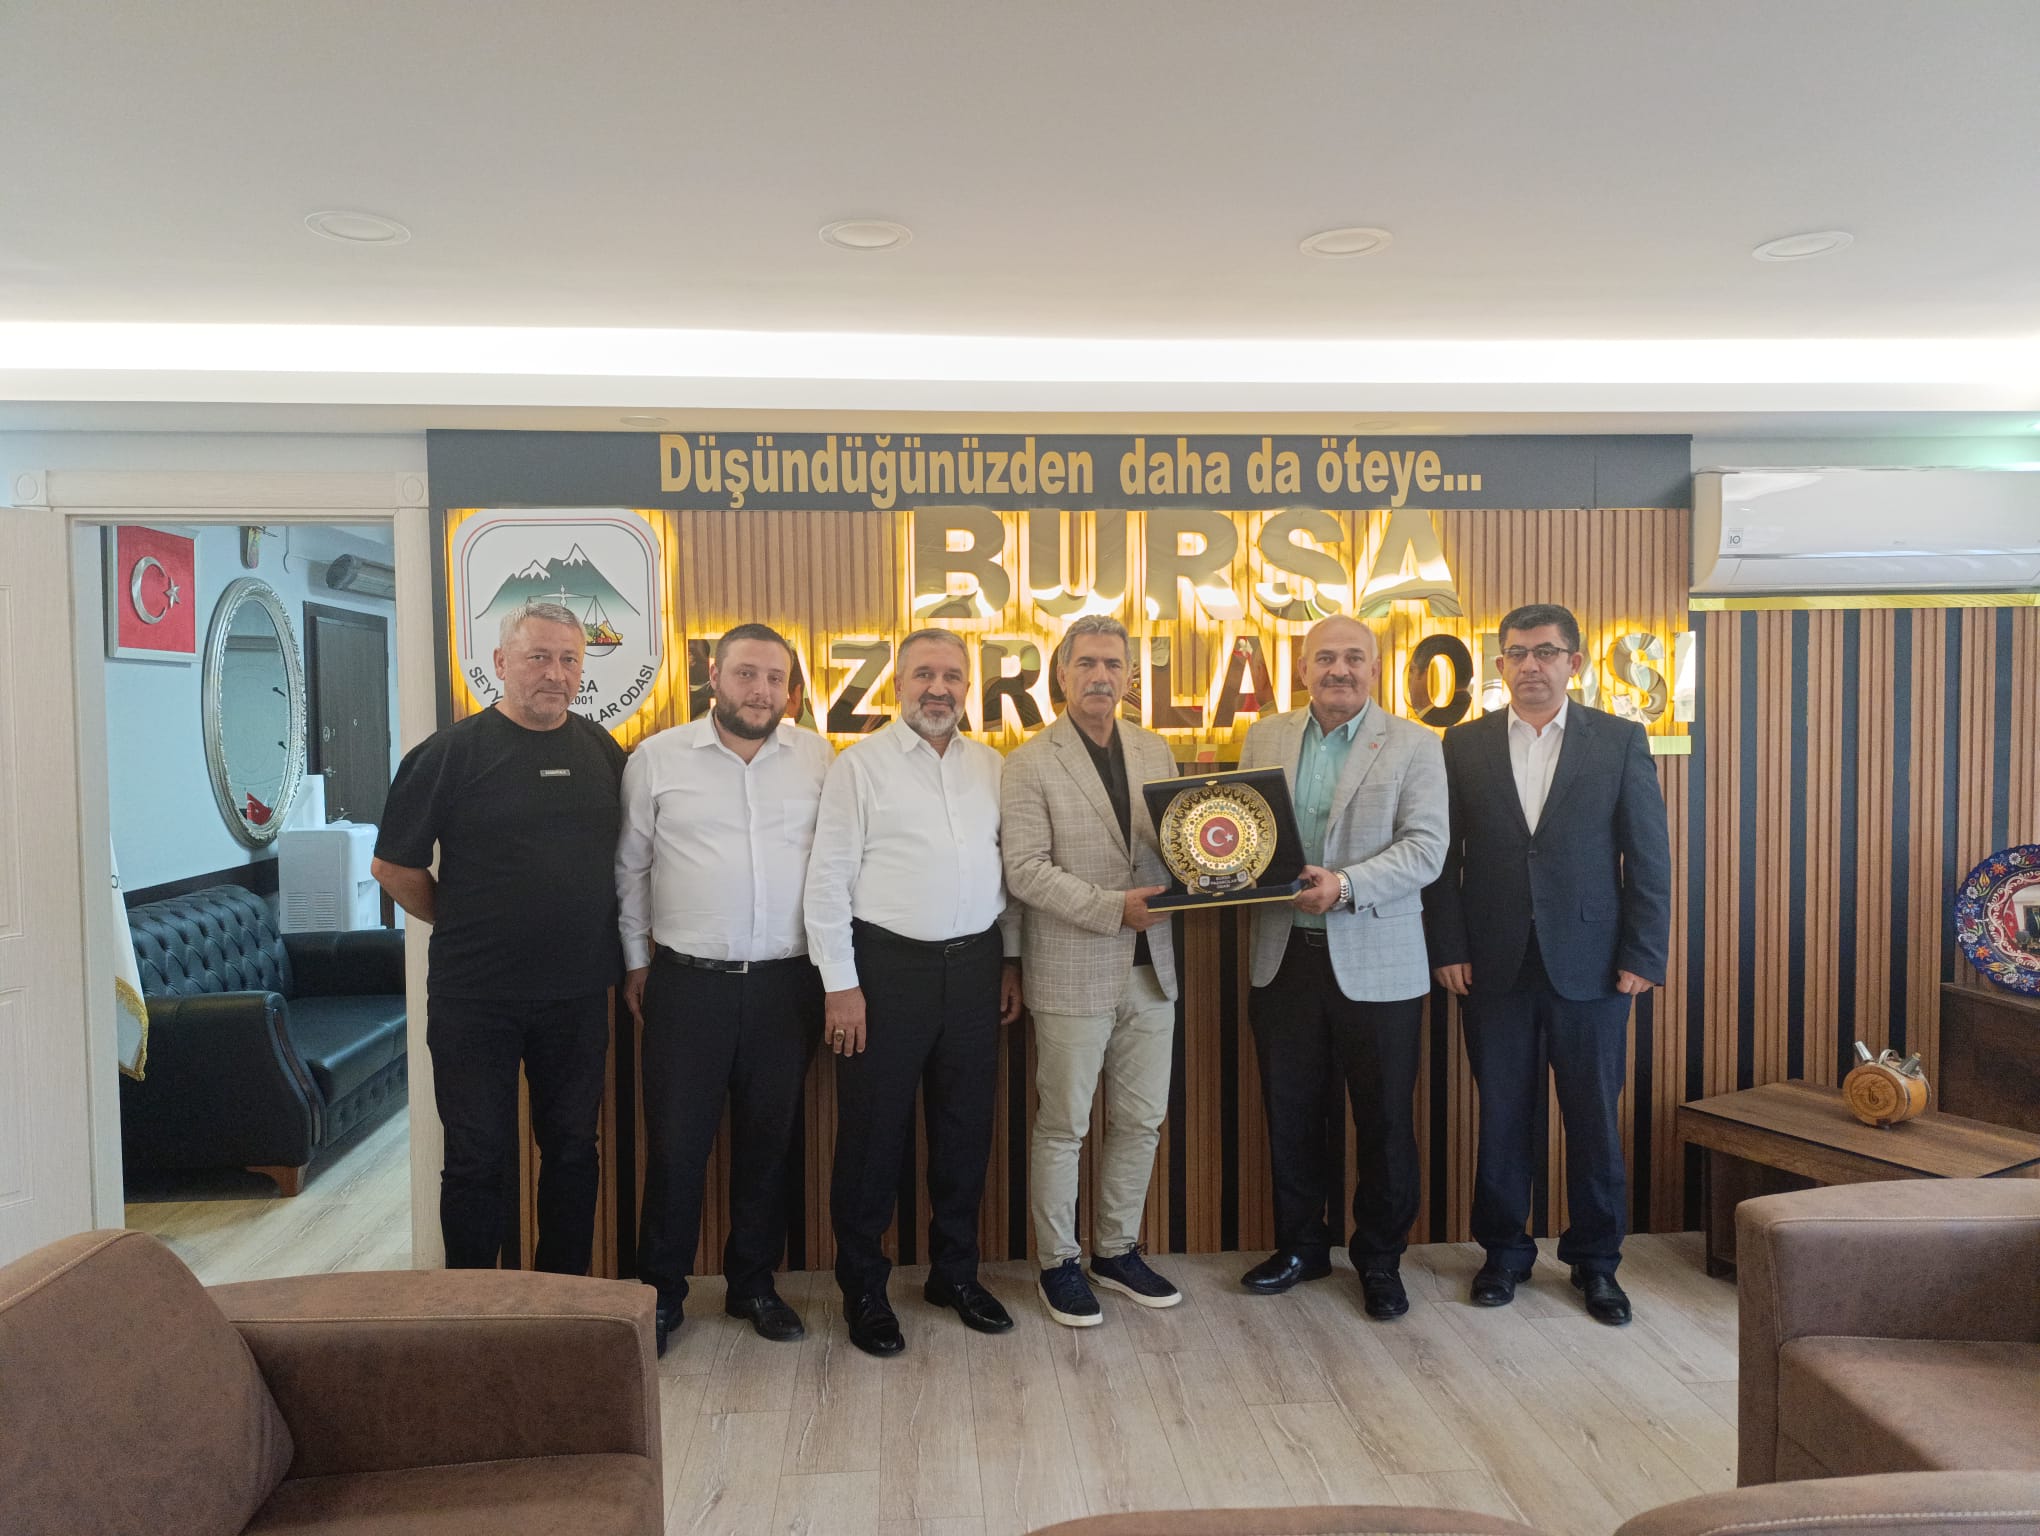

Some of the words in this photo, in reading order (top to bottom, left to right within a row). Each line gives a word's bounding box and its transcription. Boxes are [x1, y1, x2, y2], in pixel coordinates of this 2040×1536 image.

[658, 433, 1093, 509] Düşündüğünüzden
[1119, 437, 1231, 495] daha
[1246, 437, 1301, 494] da
[1316, 437, 1482, 508] öteye...
[913, 505, 1465, 622] BURSA
[570, 695, 593, 706] 001
[619, 664, 655, 707] ODASI
